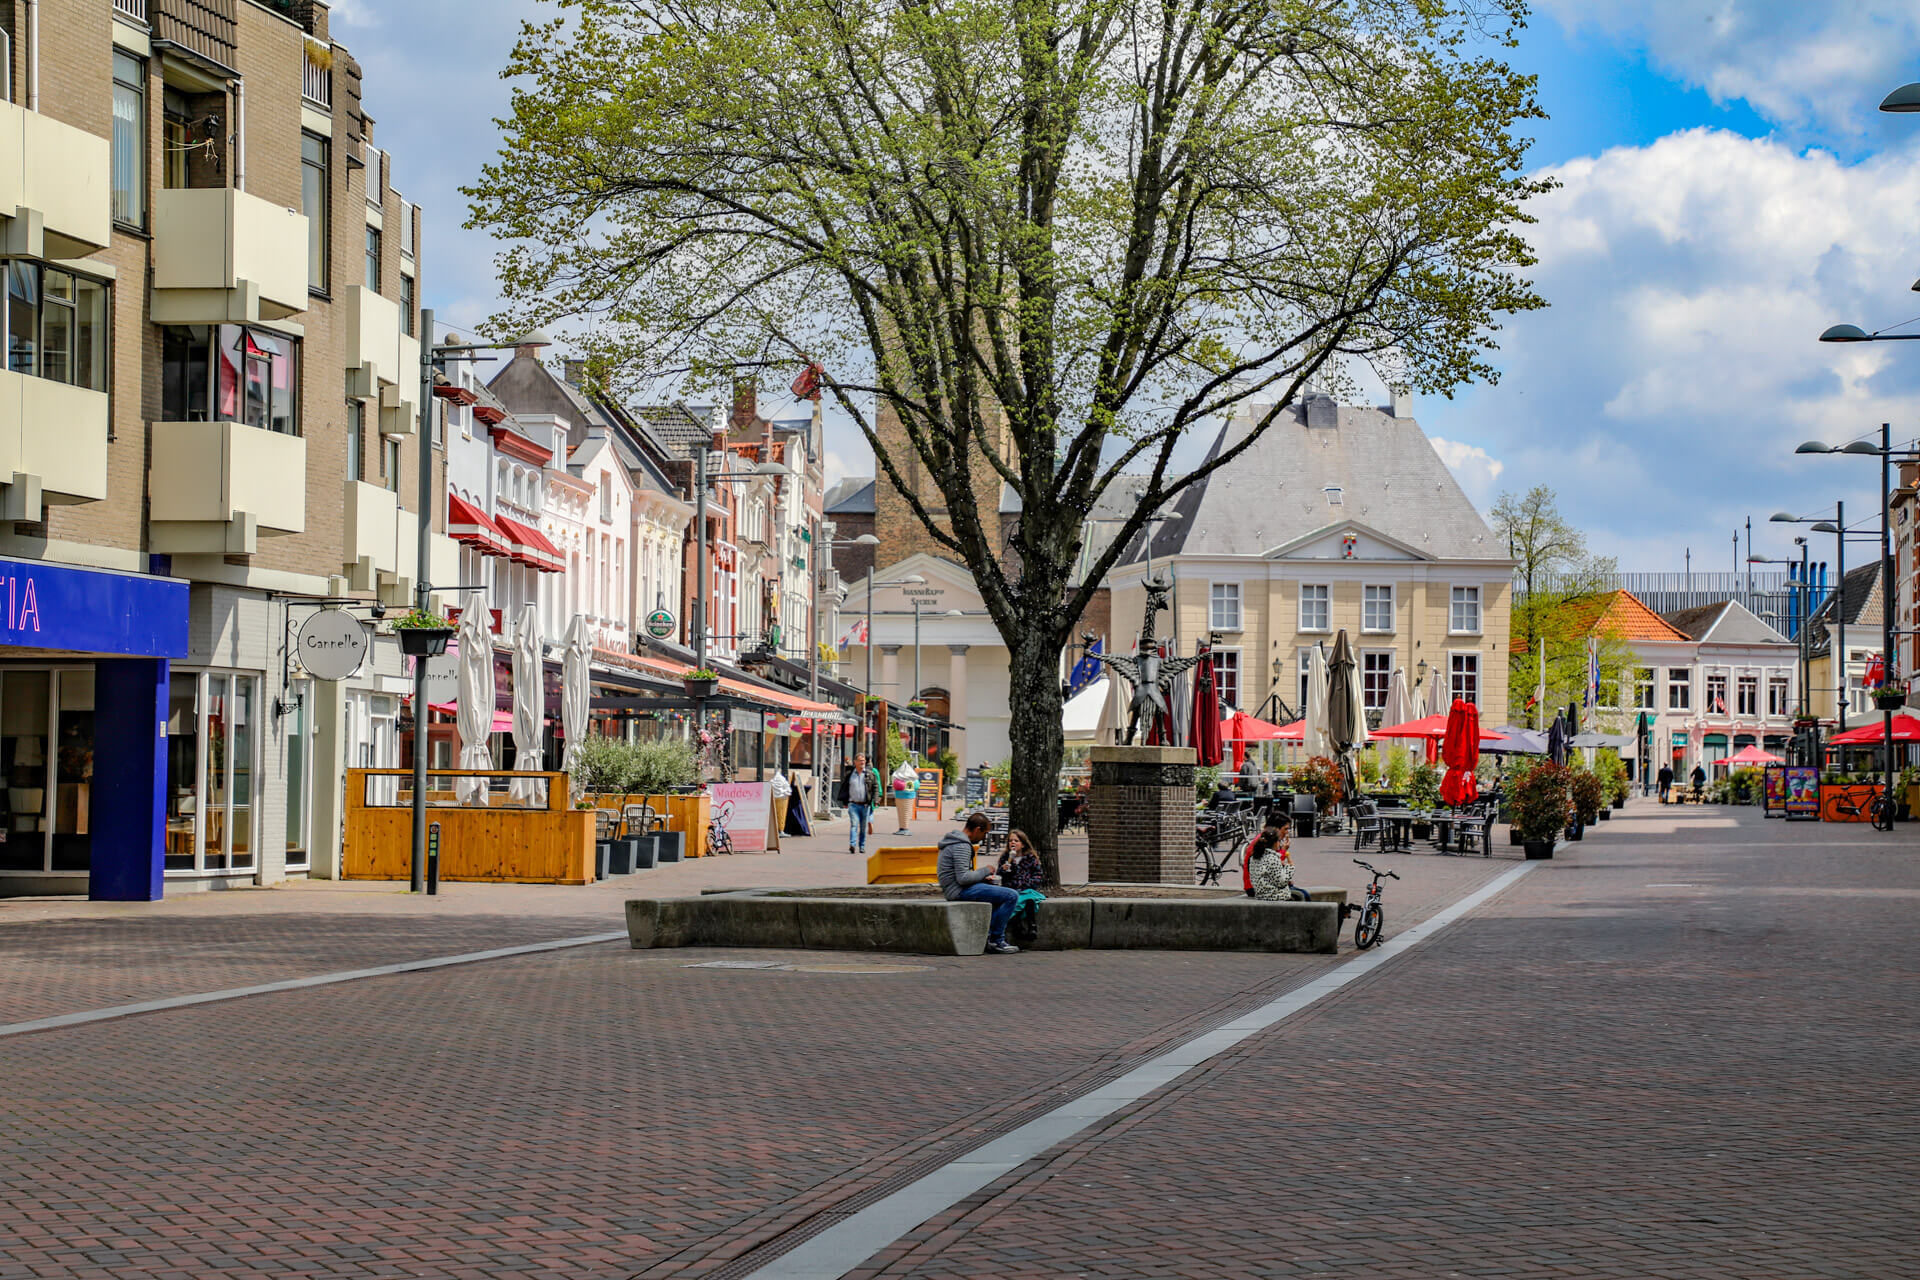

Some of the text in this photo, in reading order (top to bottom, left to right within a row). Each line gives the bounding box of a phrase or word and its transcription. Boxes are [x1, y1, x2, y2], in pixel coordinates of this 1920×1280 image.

[0, 575, 40, 632] IA
[307, 633, 359, 649] Cannelle
[426, 669, 458, 681] annelle
